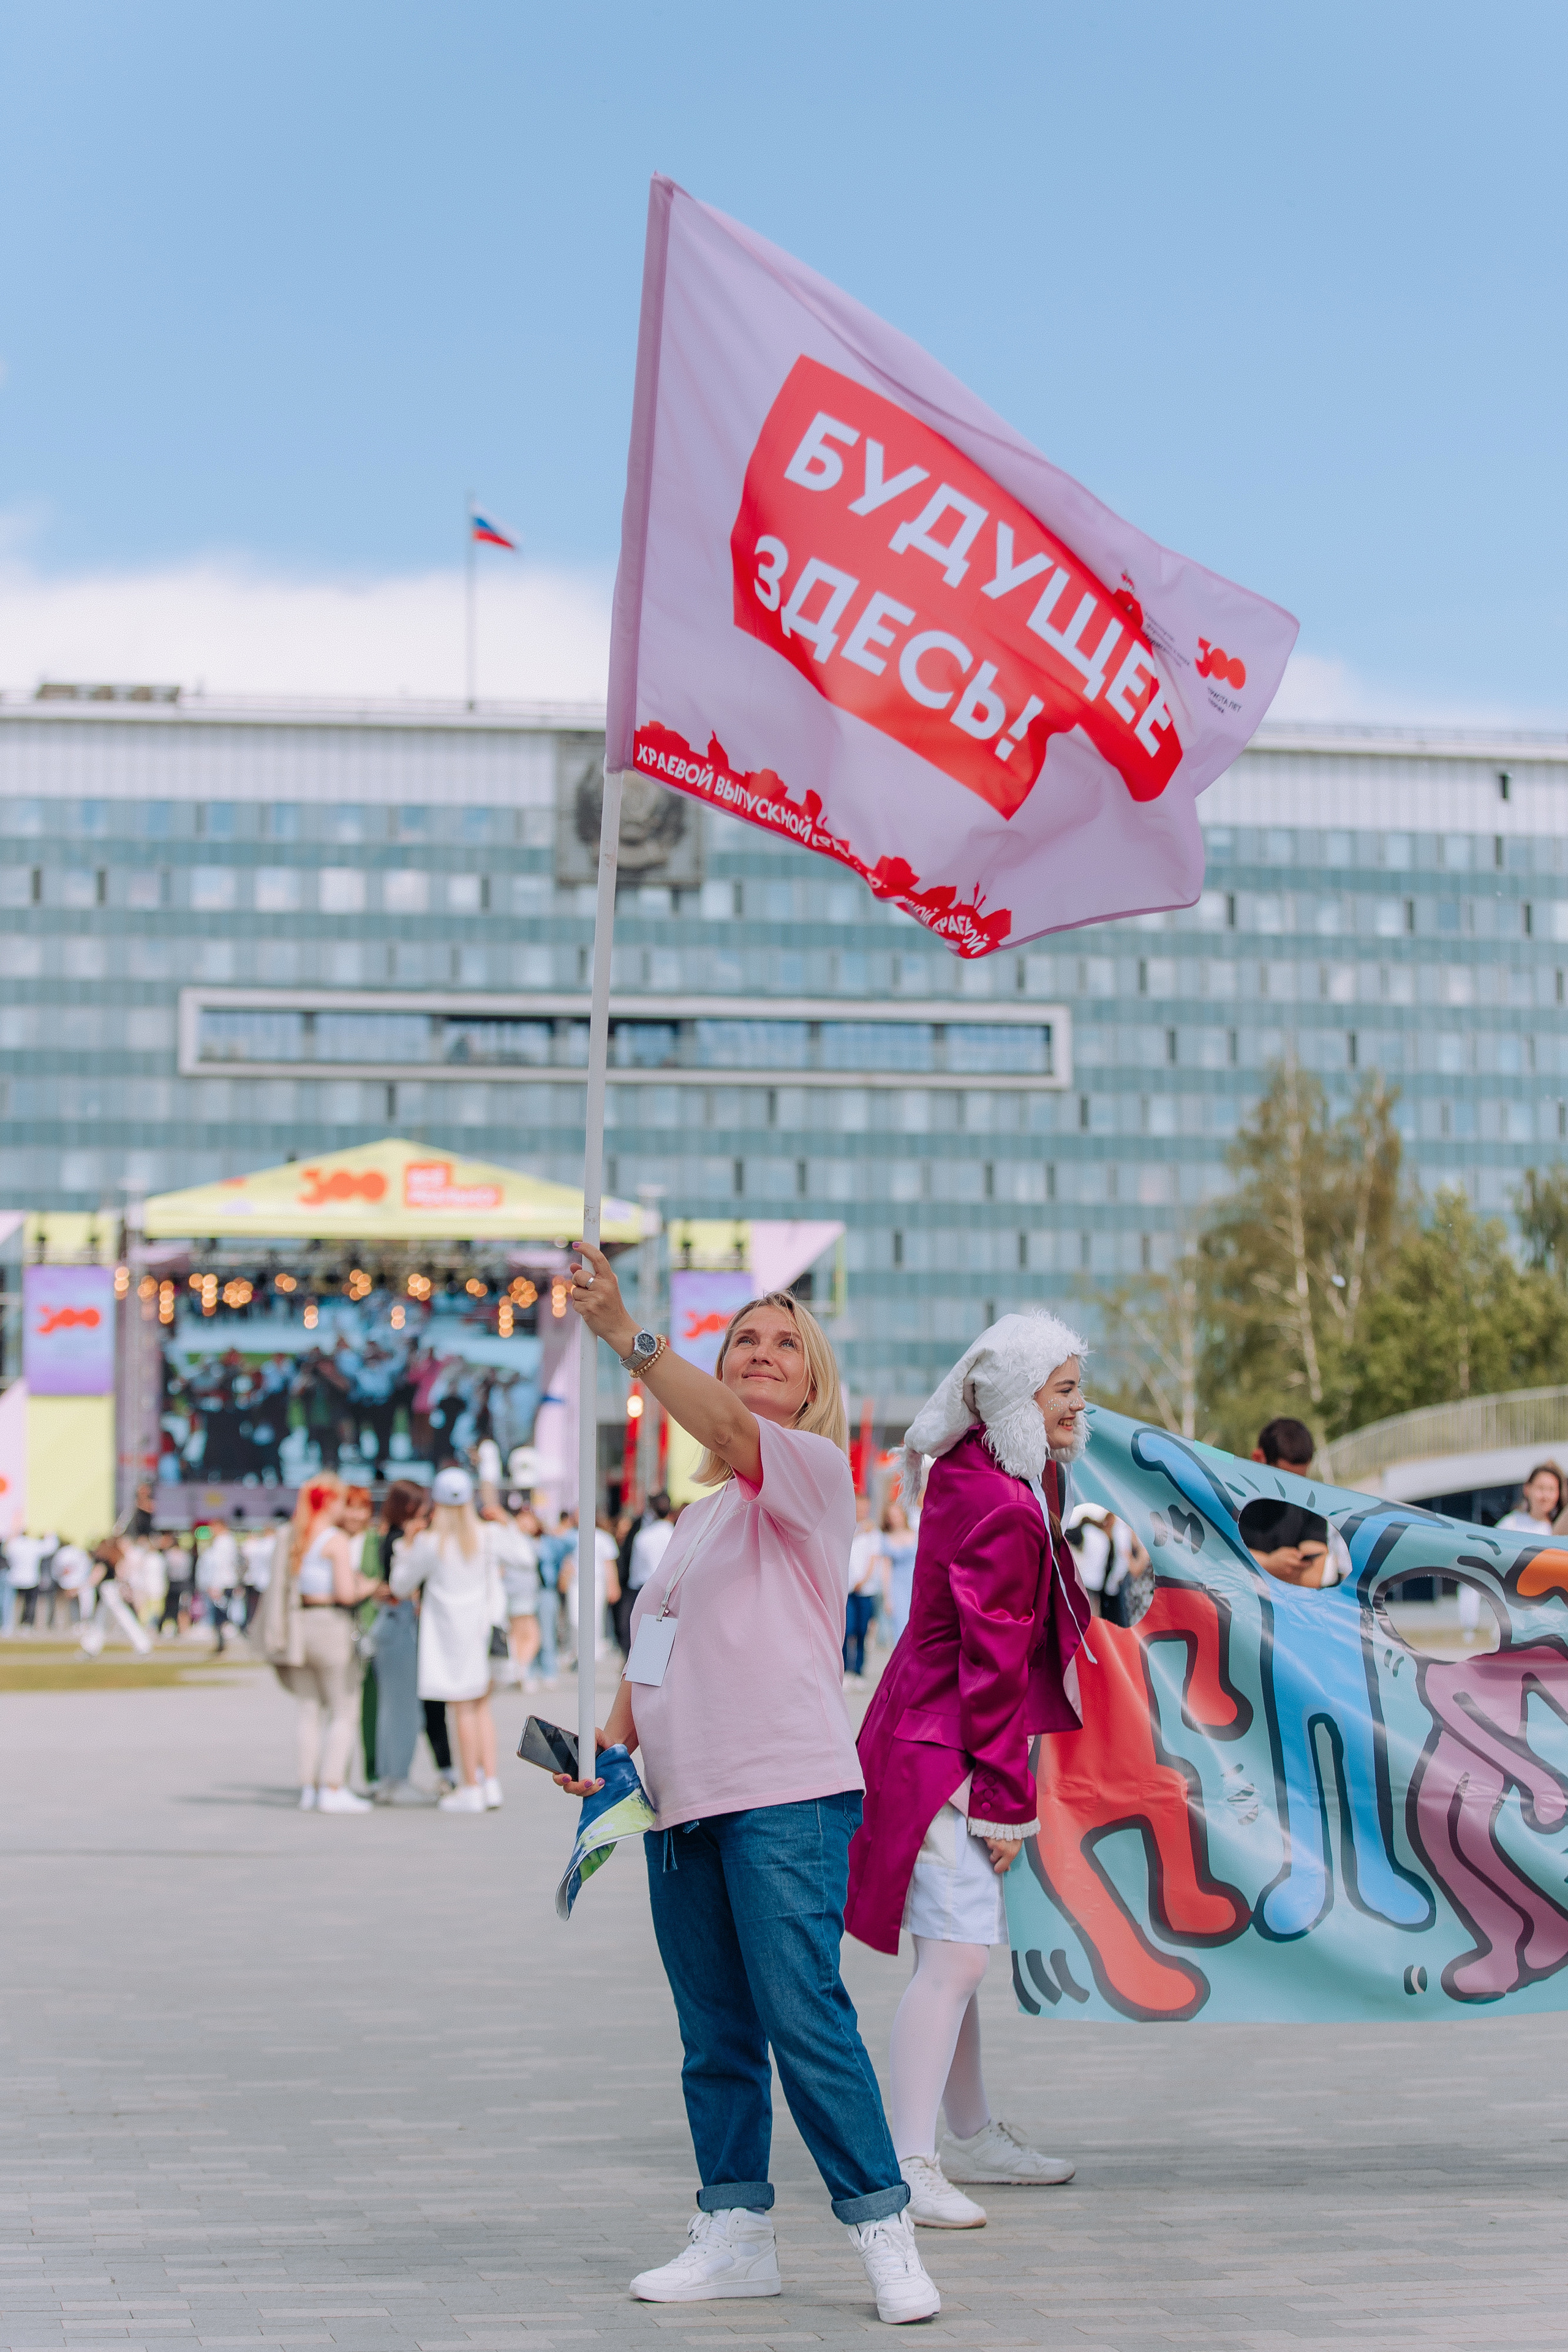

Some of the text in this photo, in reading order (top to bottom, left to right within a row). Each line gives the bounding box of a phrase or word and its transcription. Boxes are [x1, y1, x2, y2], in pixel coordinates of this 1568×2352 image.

[753, 535, 1044, 762] ЗДЕСЬ!
[783, 411, 1172, 758] БУДУЩЕЕ
[714, 775, 813, 843] ВЫПУСКНОЙ
